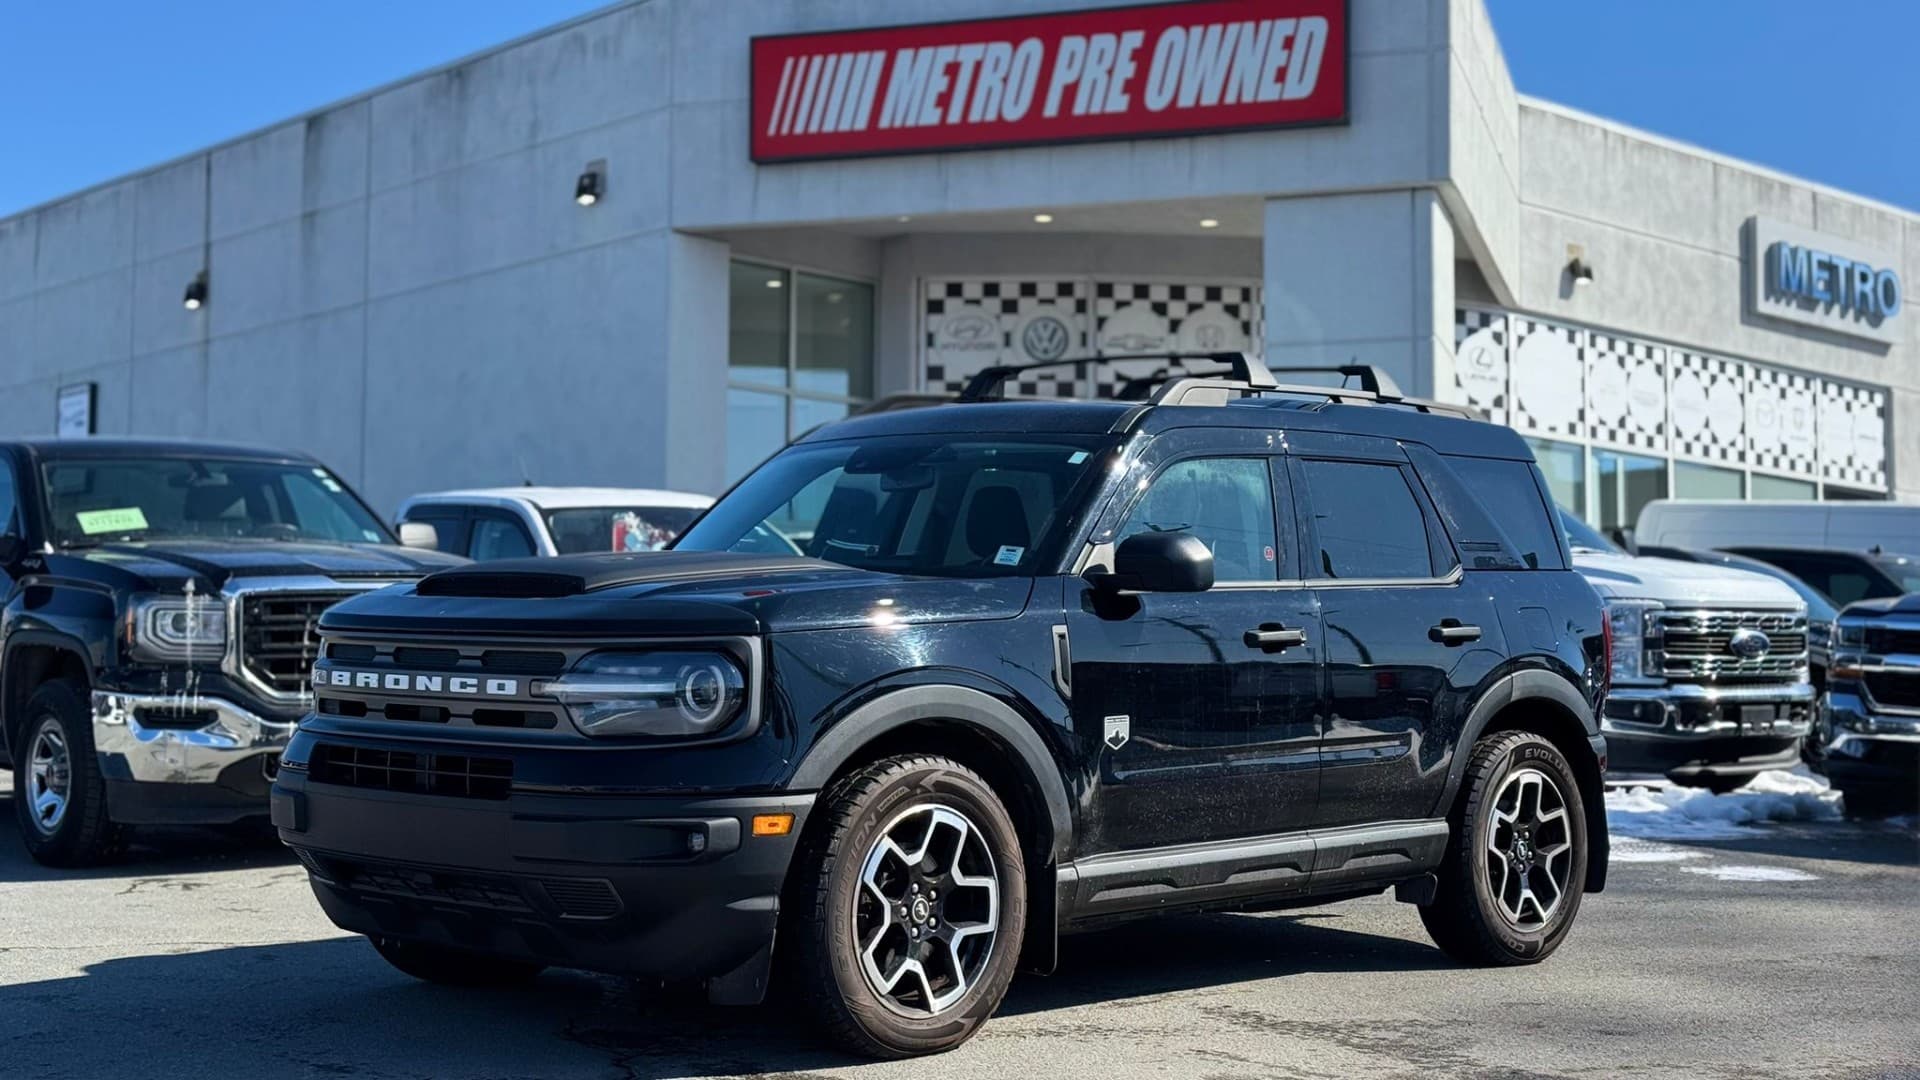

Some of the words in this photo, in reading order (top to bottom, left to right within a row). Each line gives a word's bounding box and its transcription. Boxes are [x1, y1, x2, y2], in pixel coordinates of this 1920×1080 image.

[877, 38, 1044, 130] METRO
[1043, 31, 1145, 118] PRE
[1144, 16, 1328, 113] OWNED
[1780, 240, 1902, 318] METRO
[331, 670, 517, 695] BRONCO
